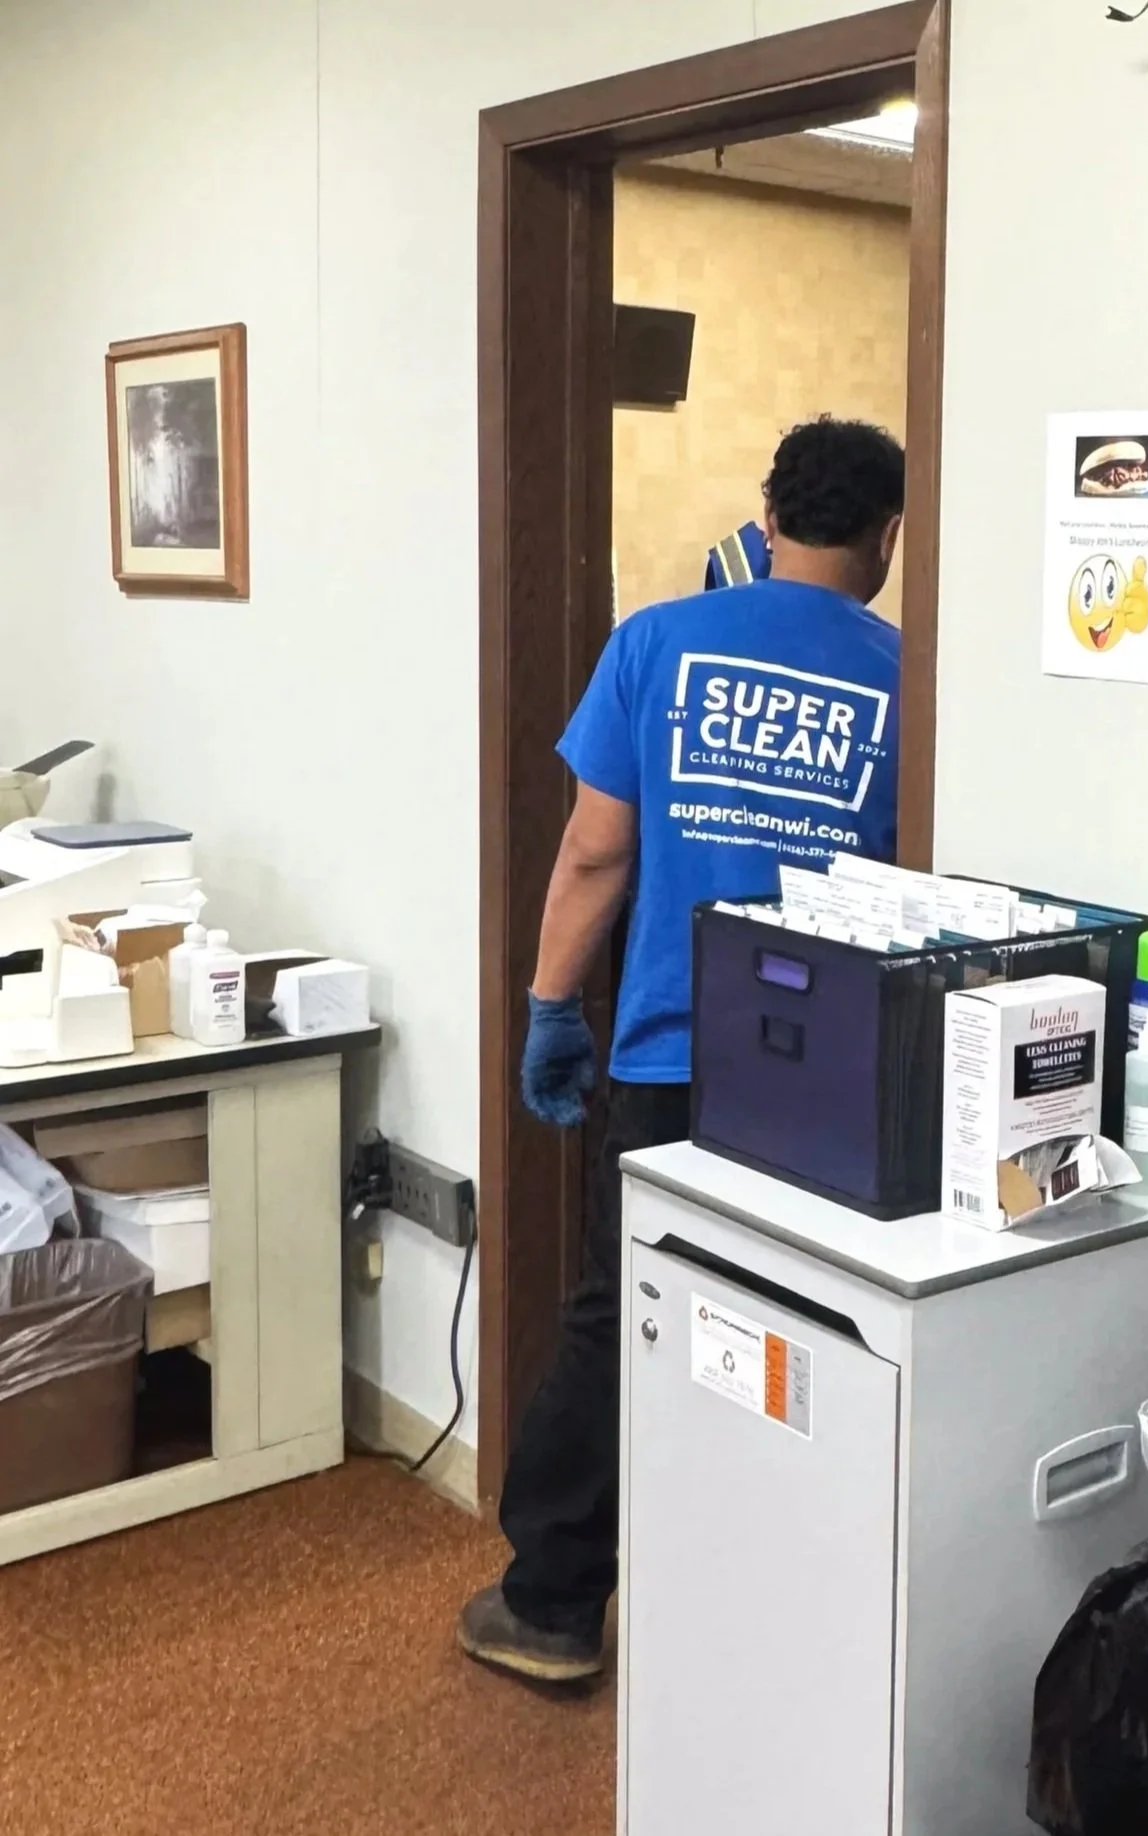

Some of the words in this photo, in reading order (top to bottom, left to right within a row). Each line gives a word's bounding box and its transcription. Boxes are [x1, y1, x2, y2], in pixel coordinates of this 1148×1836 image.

[702, 676, 856, 738] SUPER
[699, 712, 851, 773] CLEAN
[774, 764, 850, 790] SERVICES
